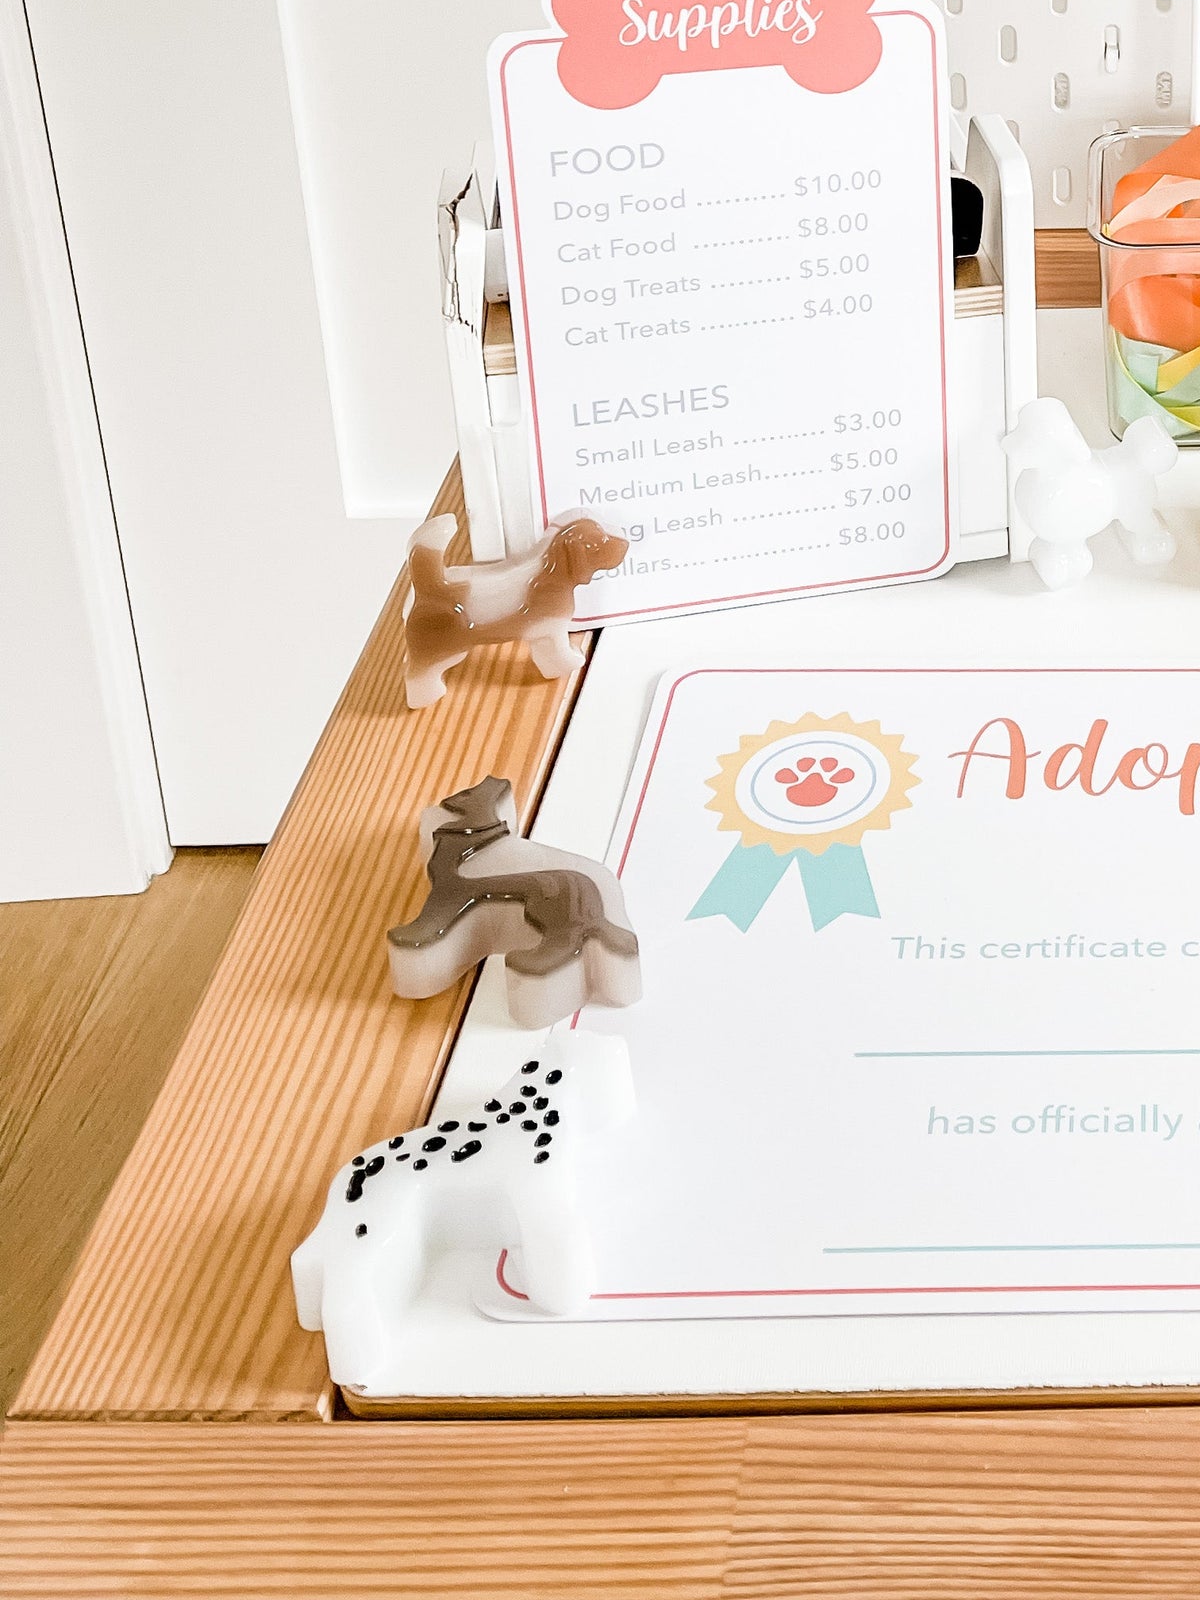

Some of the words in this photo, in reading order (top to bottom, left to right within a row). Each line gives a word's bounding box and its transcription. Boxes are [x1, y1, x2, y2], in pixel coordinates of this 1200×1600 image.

[550, 142, 665, 177] FOOD
[553, 200, 611, 223] Dog
[619, 188, 687, 215] Food
[794, 168, 882, 197] $10.00
[557, 241, 602, 264] Cat
[609, 232, 676, 258] Food
[797, 212, 869, 238] $8.00
[560, 285, 618, 307] Dog
[623, 275, 701, 299] Treats
[799, 253, 870, 280] $5.00
[564, 325, 609, 347] Cat
[614, 317, 691, 342] Treats
[803, 293, 874, 320] $4.00
[572, 383, 731, 429] LEASHES
[575, 439, 645, 468] Small
[653, 429, 724, 457] Leash
[832, 408, 903, 435] $3.00
[578, 478, 684, 506] Medium
[830, 446, 899, 473] $5.00
[653, 507, 723, 535] Leash
[843, 482, 912, 508] $7.00
[838, 520, 906, 547] $8.00
[890, 935, 967, 960] This
[979, 933, 1168, 959] certificate
[925, 1104, 997, 1136] has
[1010, 1103, 1184, 1141] officially
